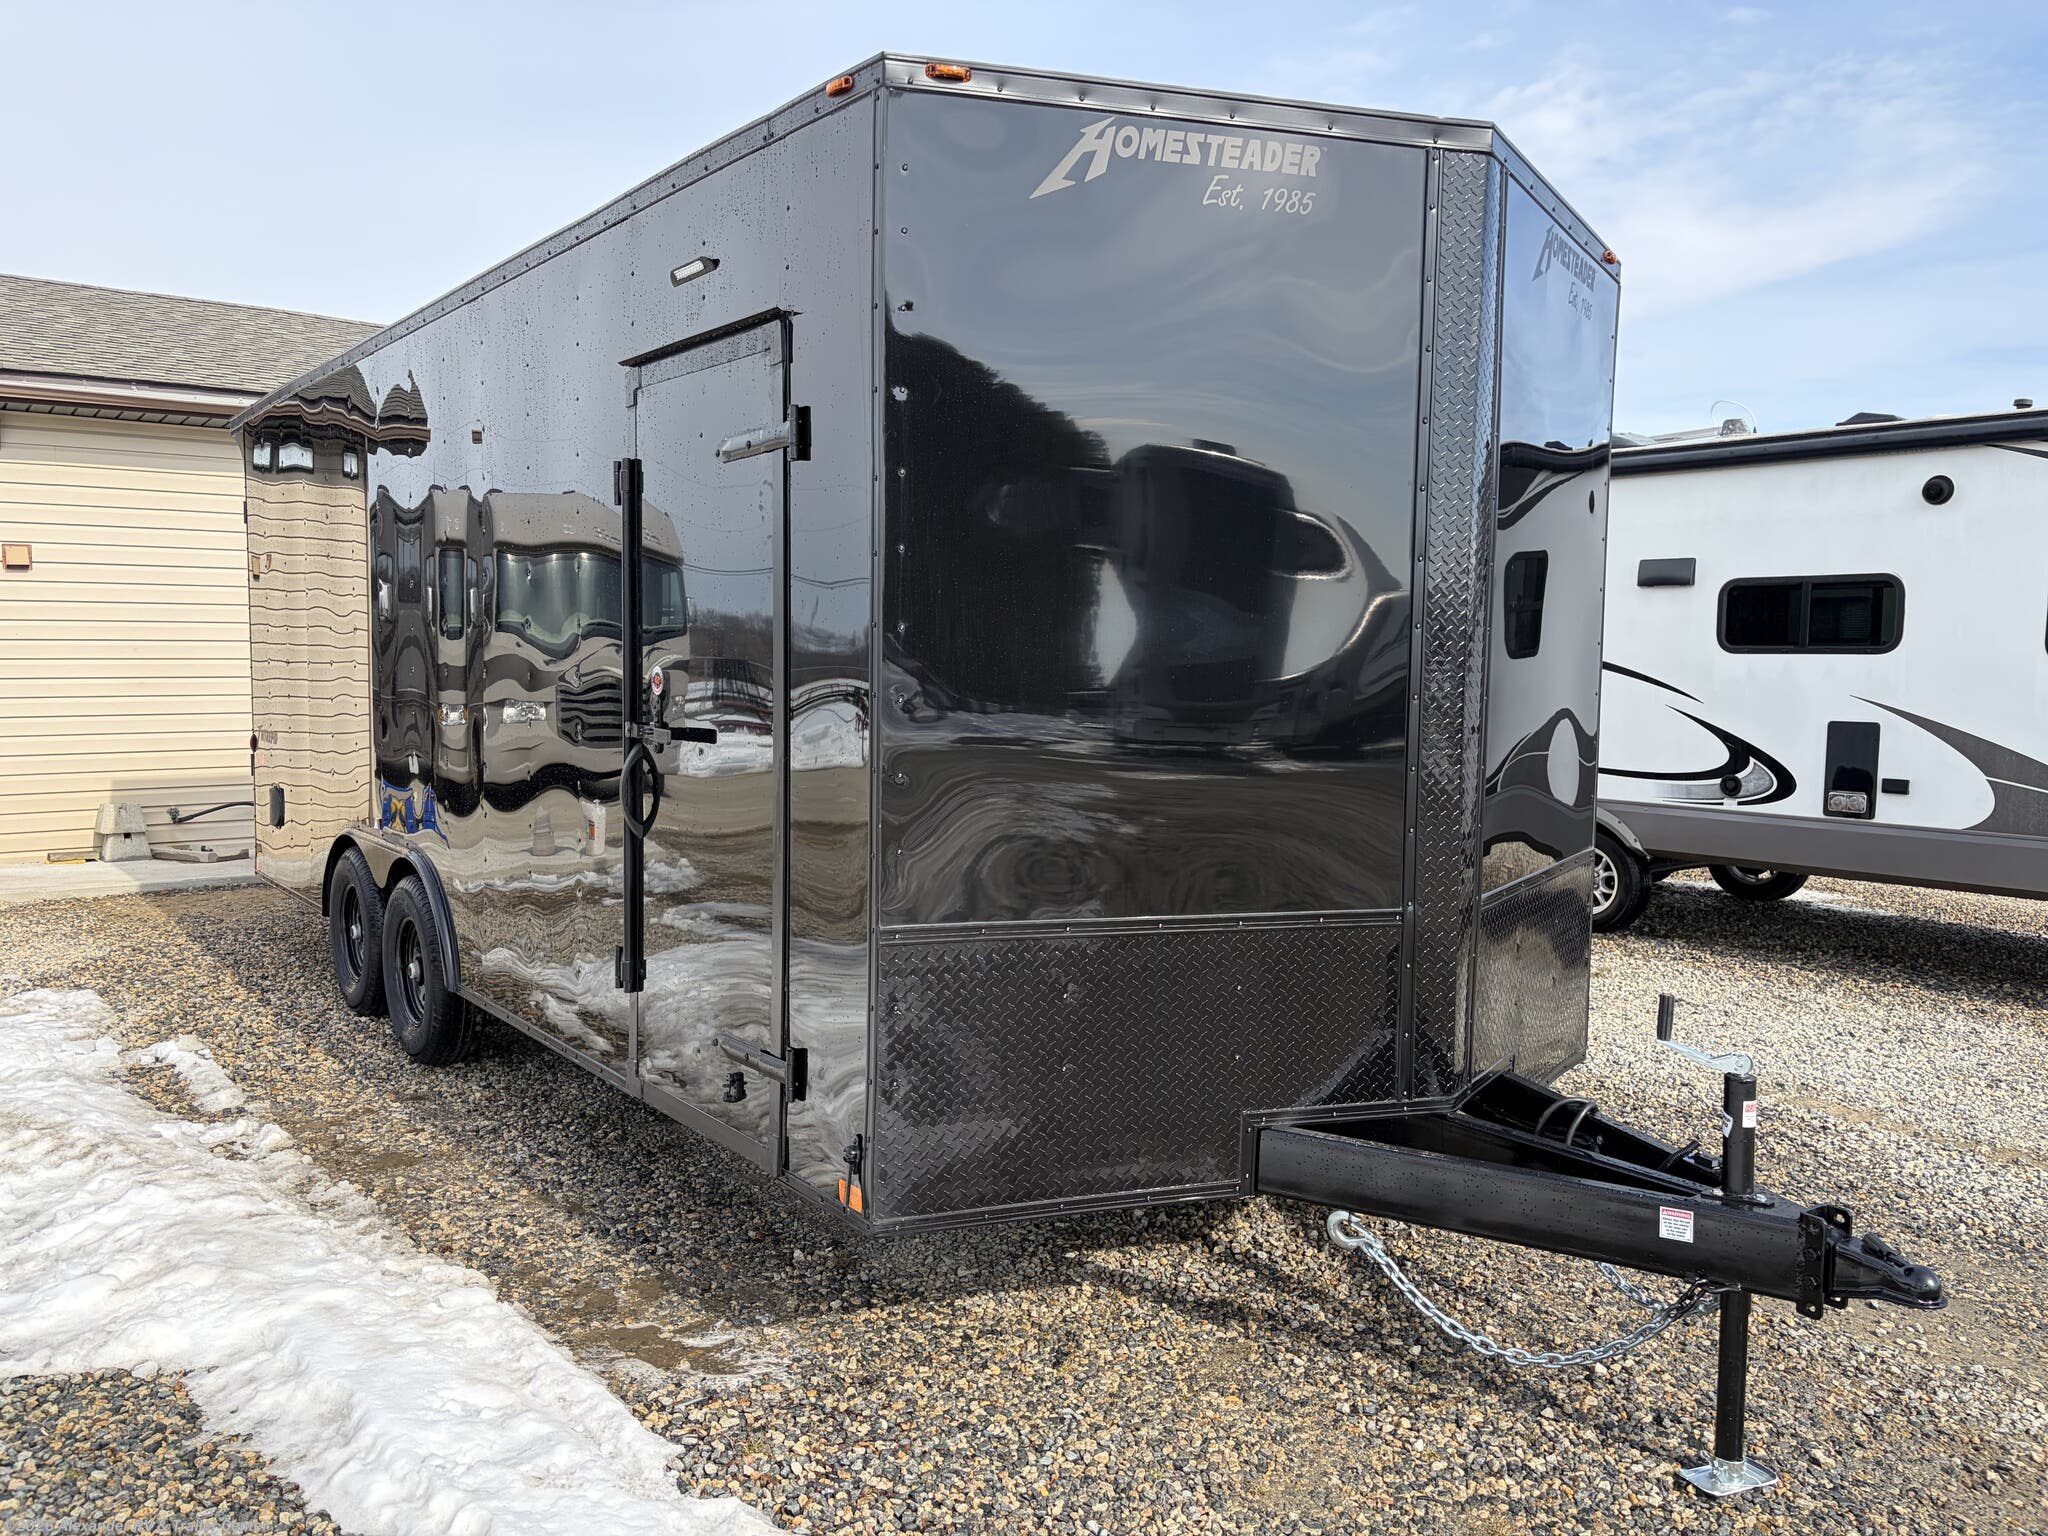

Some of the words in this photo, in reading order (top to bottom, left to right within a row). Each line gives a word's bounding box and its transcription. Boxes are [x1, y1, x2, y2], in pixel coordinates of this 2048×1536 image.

[1029, 116, 1321, 199] HOMESTEADER
[1260, 187, 1316, 215] 1985
[1532, 223, 1596, 292] HOMESTEADER
